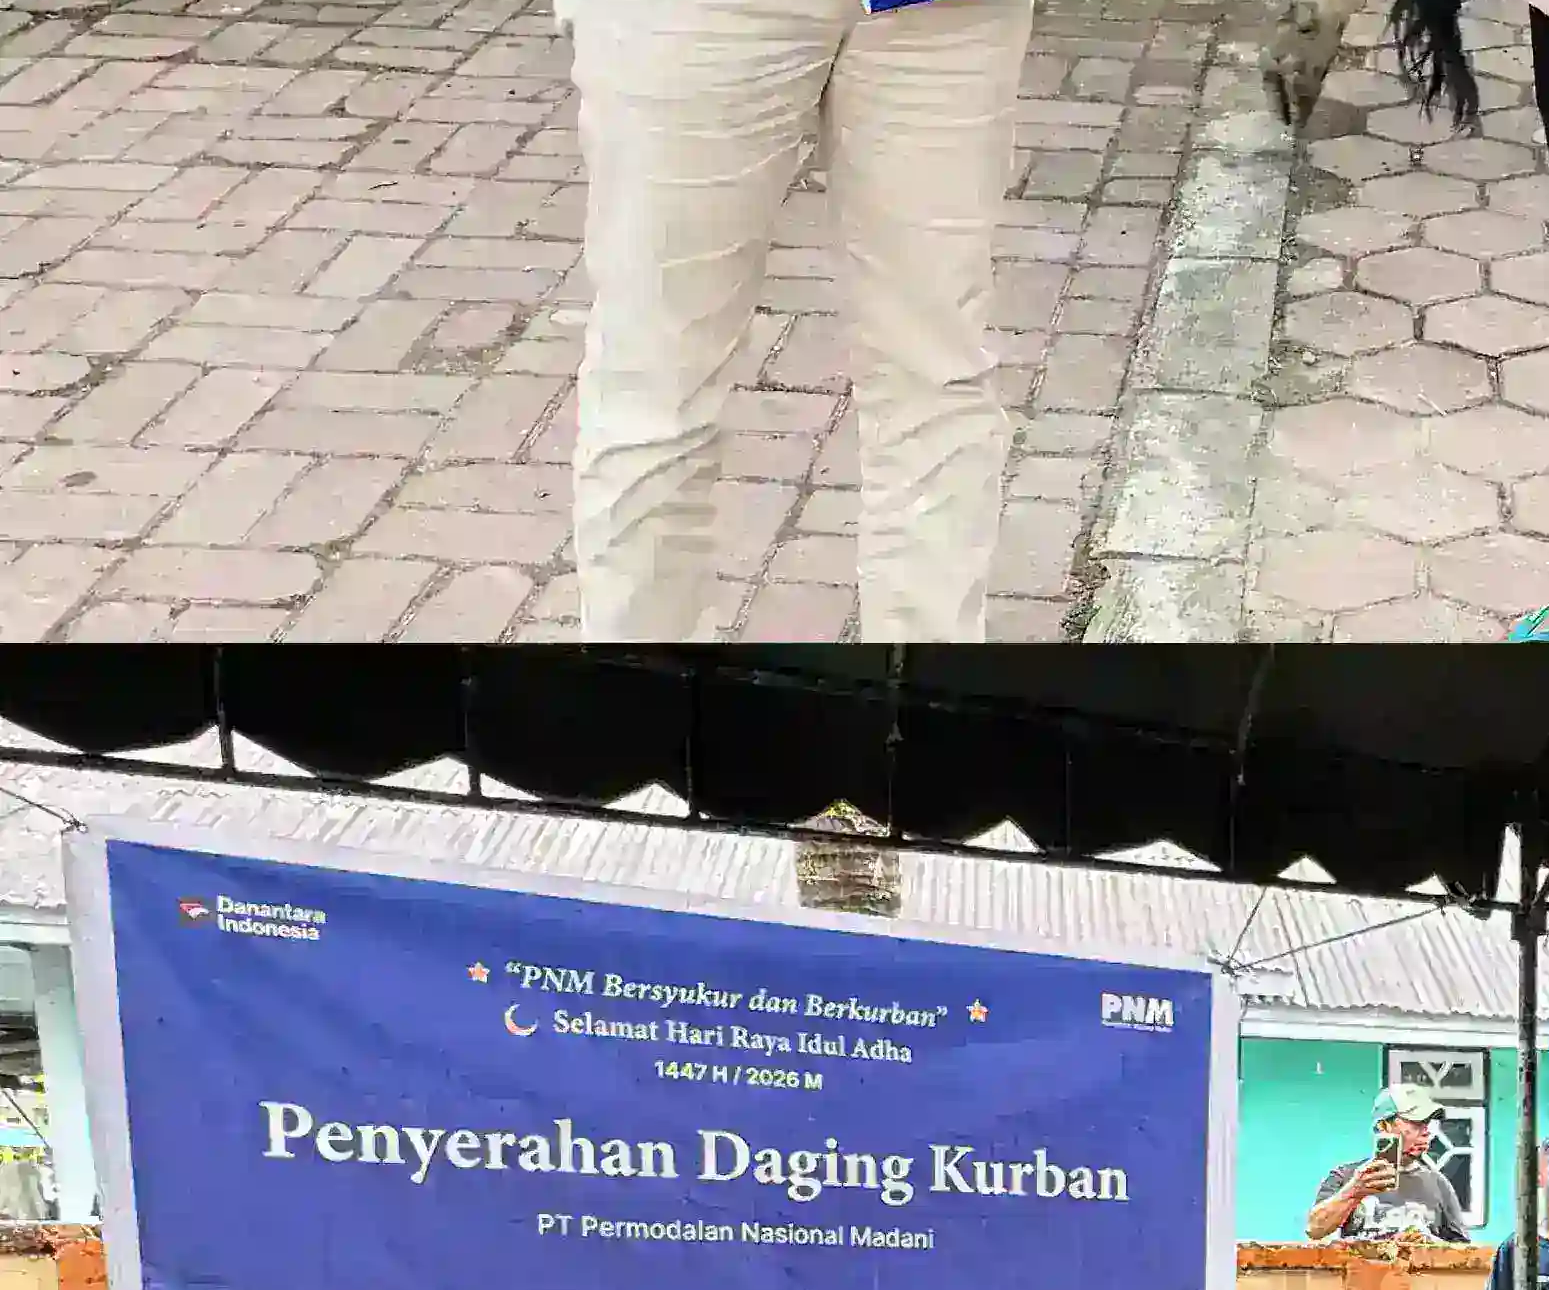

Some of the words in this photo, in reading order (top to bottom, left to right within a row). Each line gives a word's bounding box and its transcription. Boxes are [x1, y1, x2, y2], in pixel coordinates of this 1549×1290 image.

[217, 894, 327, 924] Danantara
[217, 914, 320, 940] Indonesia
[601, 973, 744, 1009] Bersyukur
[748, 988, 799, 1013] dan
[1101, 993, 1174, 1026] PNM
[553, 1009, 659, 1041] Selamat
[665, 1019, 724, 1047] Hari
[730, 1025, 792, 1056] Raya
[796, 1032, 848, 1057] Idul
[851, 1037, 913, 1063] Adha
[654, 1060, 707, 1080] 1447
[712, 1065, 728, 1084] H
[733, 1065, 742, 1085] /
[746, 1067, 800, 1088] 2026
[804, 1072, 823, 1090] M
[258, 1100, 679, 1184] Penyerahan
[696, 1128, 914, 1206] Daging
[928, 1143, 1130, 1201] Kurban
[537, 1213, 573, 1236] PT
[581, 1214, 733, 1242] Permodalan
[741, 1221, 844, 1247] Nasional
[850, 1225, 936, 1250] Madani
